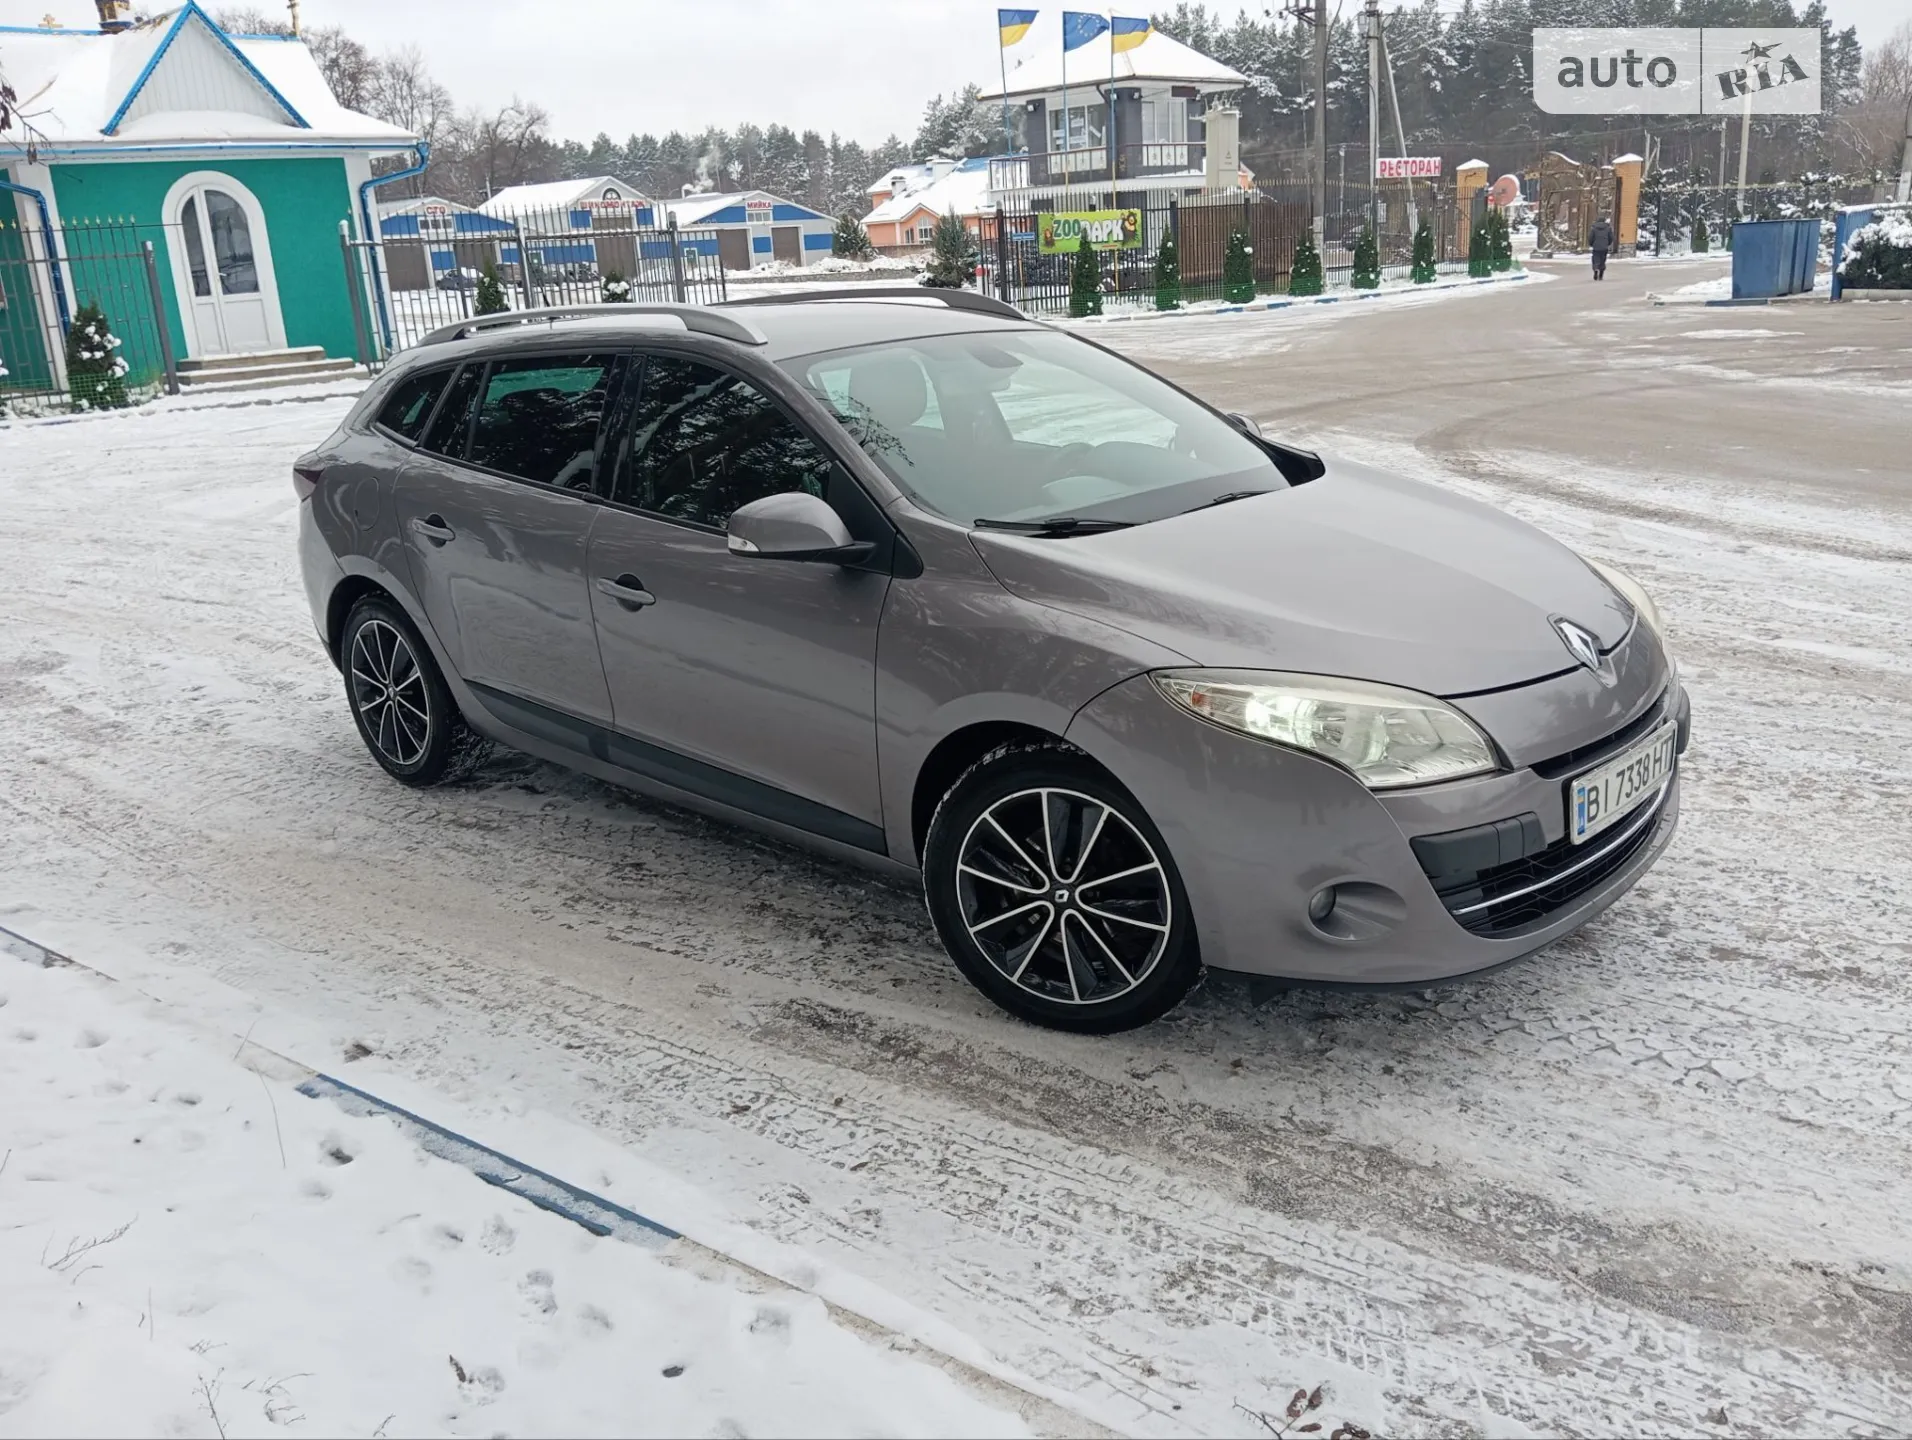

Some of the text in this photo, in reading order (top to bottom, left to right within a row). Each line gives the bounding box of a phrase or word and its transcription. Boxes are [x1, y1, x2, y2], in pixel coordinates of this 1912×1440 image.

[1380, 159, 1442, 176] РЕСТОРАН
[426, 206, 446, 215] СТО
[1587, 778, 1609, 823] BI
[1616, 753, 1651, 806] 7338
